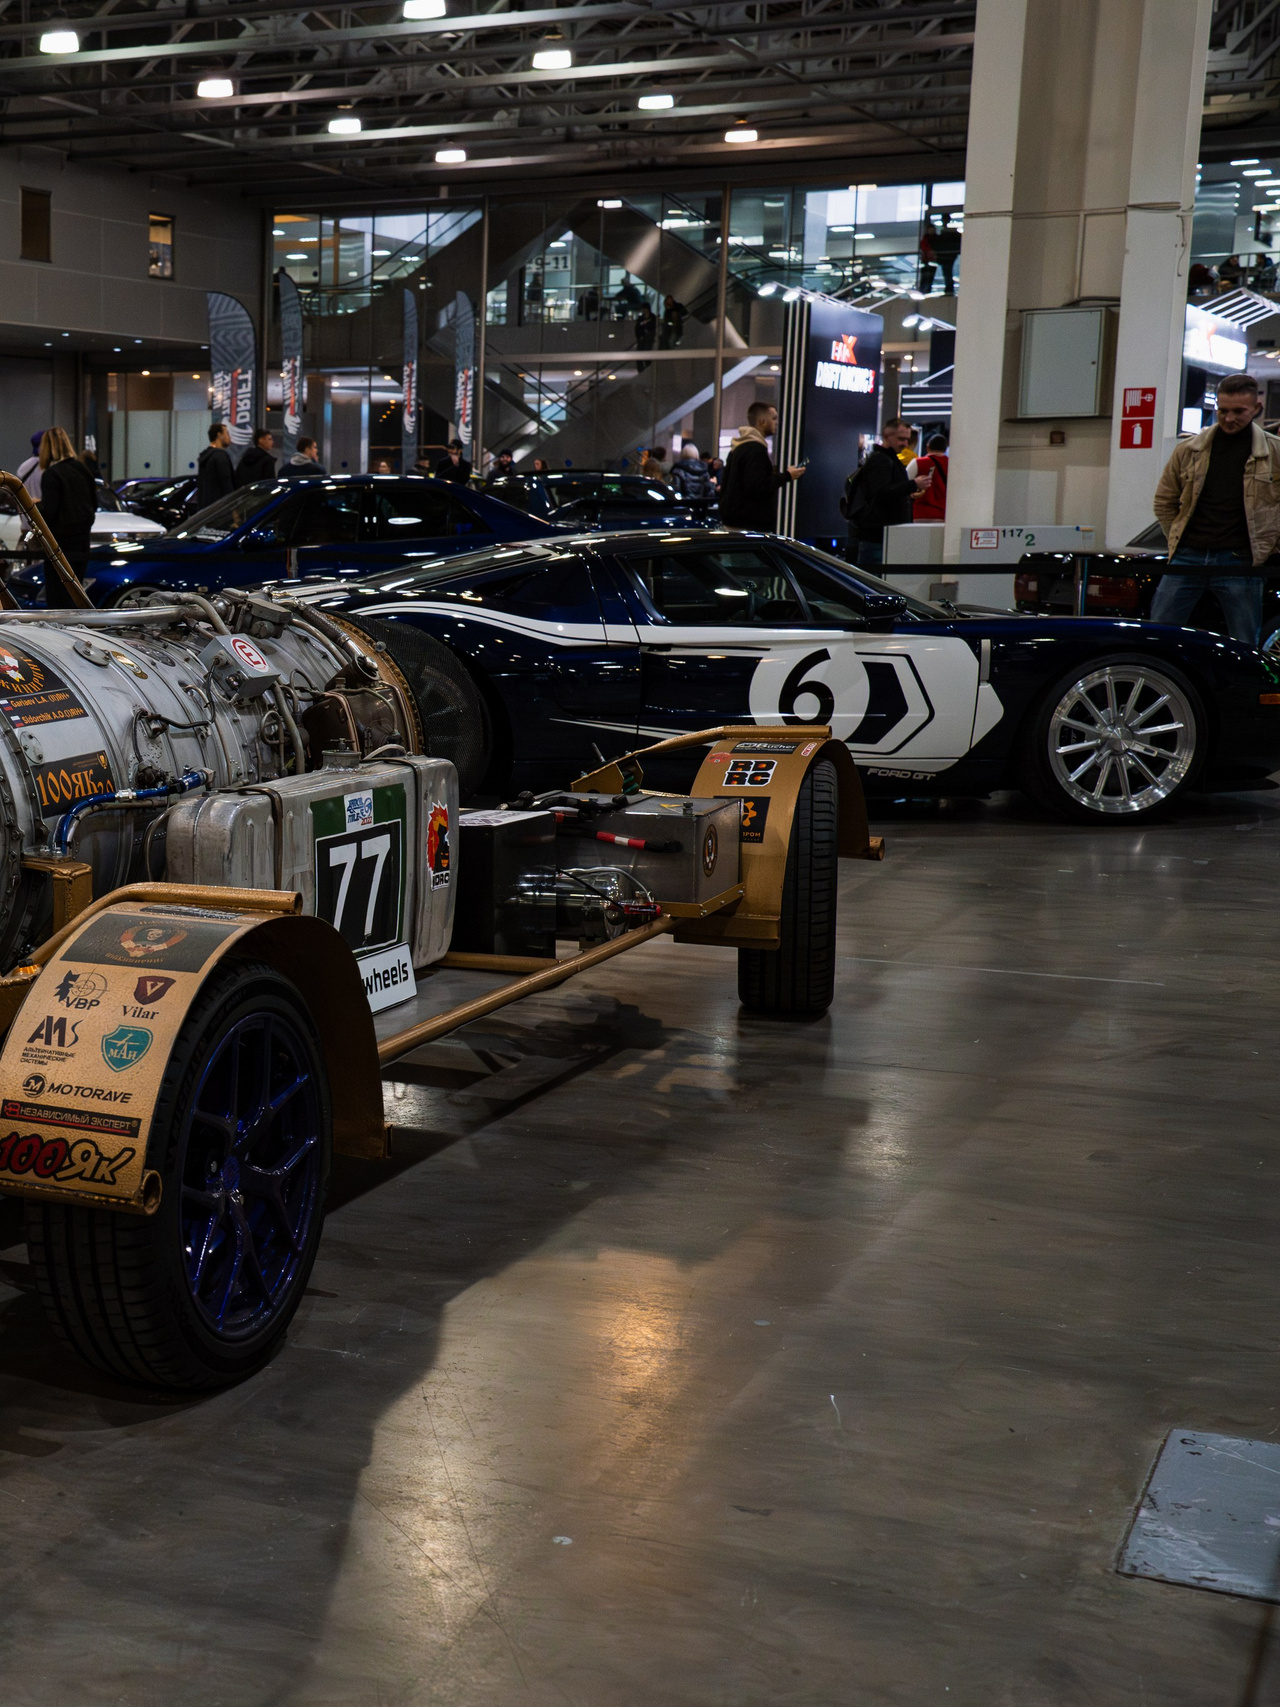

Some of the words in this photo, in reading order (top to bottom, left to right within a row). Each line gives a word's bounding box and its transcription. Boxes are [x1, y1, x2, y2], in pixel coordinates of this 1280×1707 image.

[1002, 529, 1023, 538] 117
[1024, 533, 1036, 547] 2
[778, 648, 835, 725] 6
[866, 767, 912, 779] FORD
[912, 772, 937, 781] GT
[35, 769, 99, 806] 100ЯК
[329, 833, 391, 935] 77
[122, 1005, 160, 1020] Vilar
[20, 1058, 49, 1066] СИСТЕМЫ
[47, 1083, 133, 1104] MOTORAVE
[20, 1108, 90, 1125] НЕЗАВИСИМЫЙ
[91, 1118, 131, 1130] ЭКСПЕРТ
